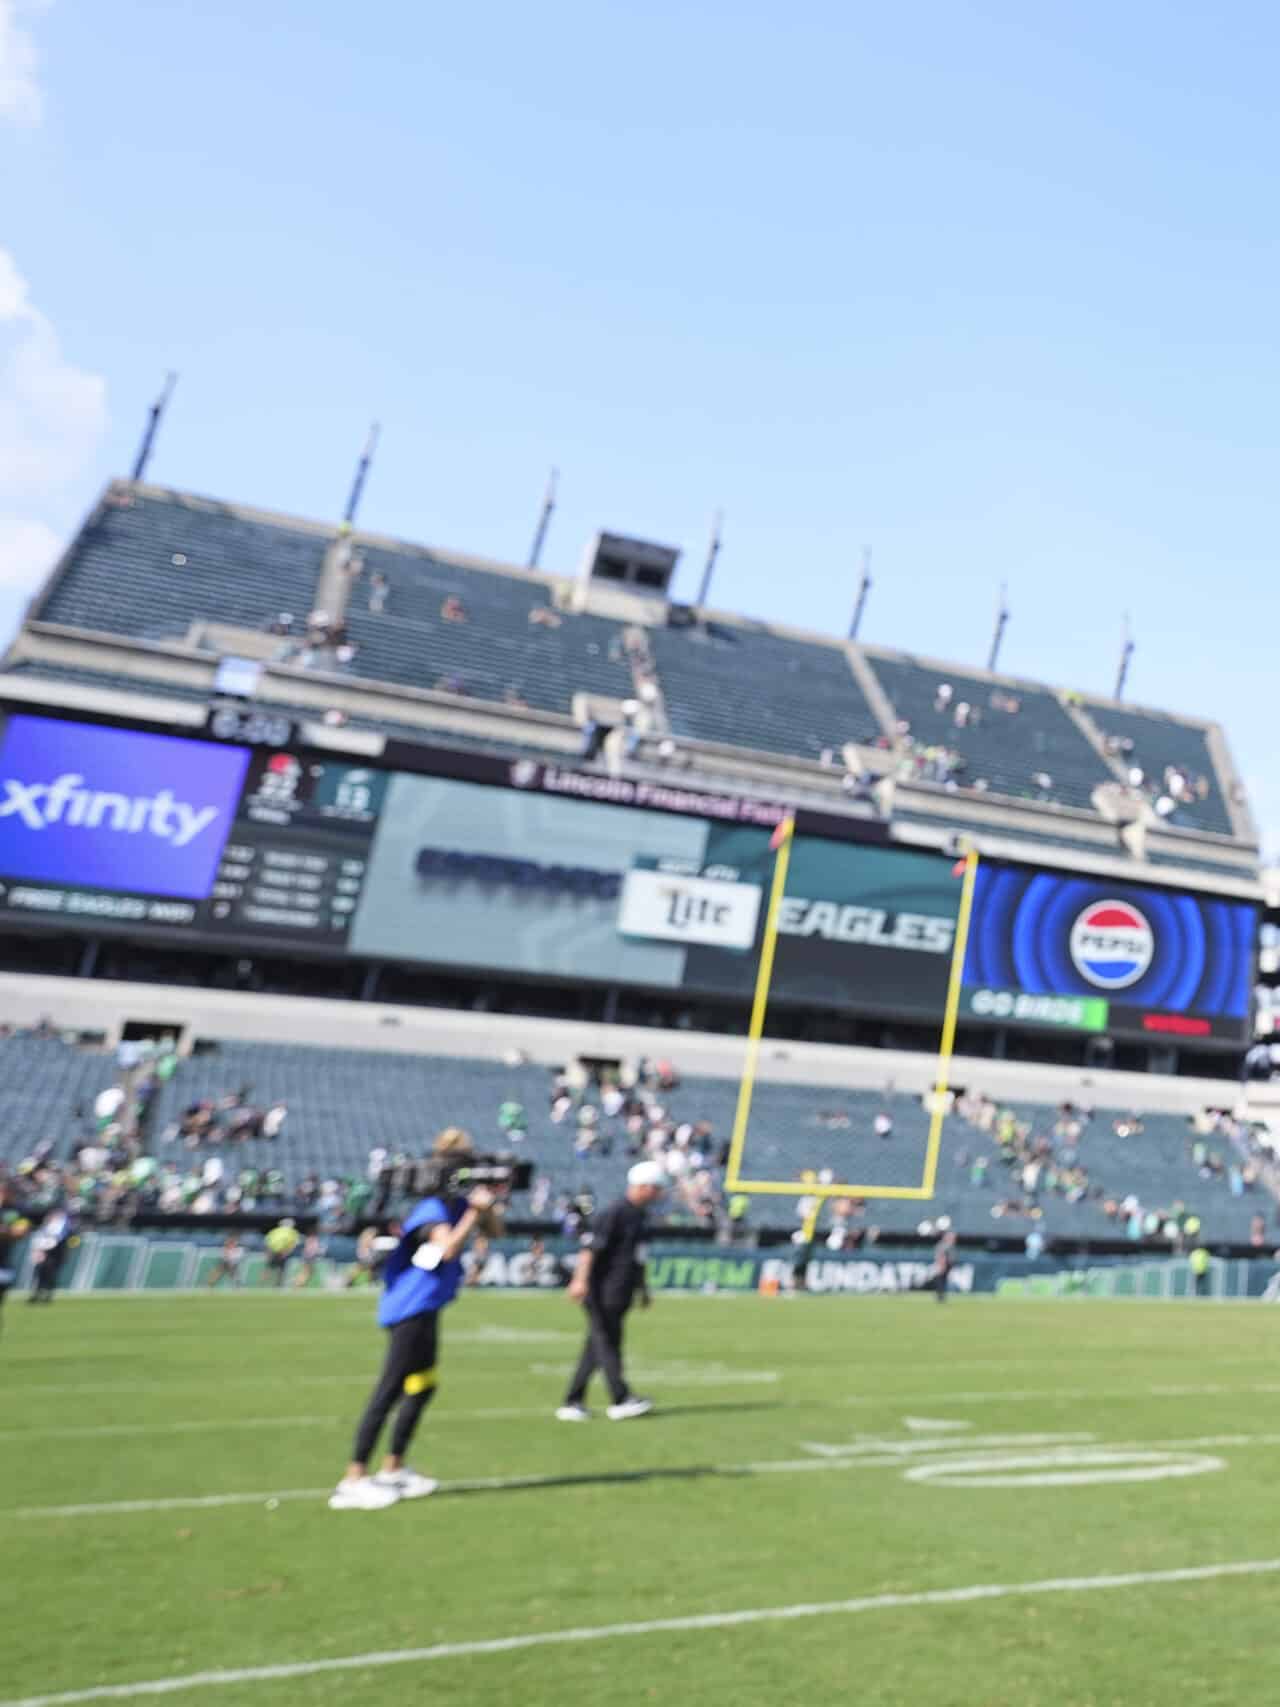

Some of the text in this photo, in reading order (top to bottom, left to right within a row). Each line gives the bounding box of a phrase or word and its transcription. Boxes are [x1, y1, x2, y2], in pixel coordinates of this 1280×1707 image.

[0, 773, 220, 847] xfinity
[543, 768, 635, 804] Lincoln
[776, 898, 955, 953] EAGLES
